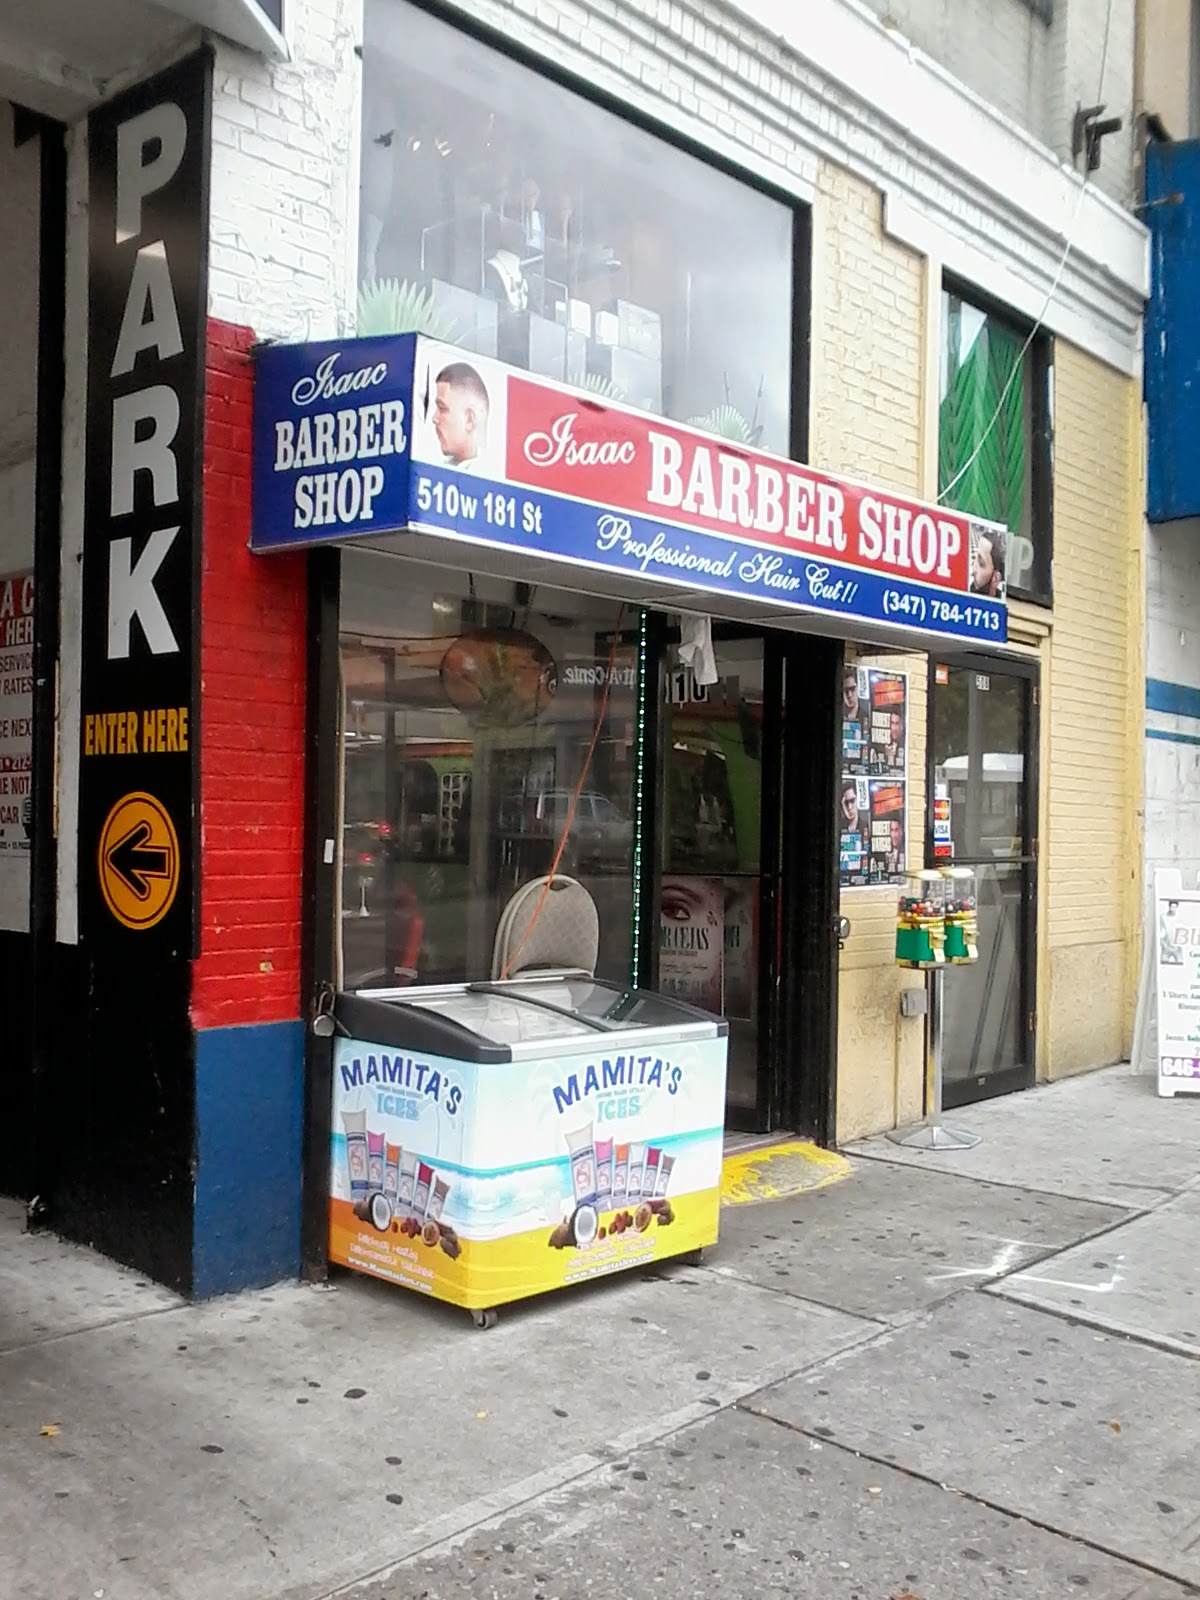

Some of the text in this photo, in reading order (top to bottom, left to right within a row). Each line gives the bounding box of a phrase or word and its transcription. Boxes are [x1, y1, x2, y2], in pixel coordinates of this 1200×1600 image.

[107, 102, 188, 660] PARK
[291, 352, 387, 406] Isaac
[274, 400, 407, 472] BARBER
[294, 465, 384, 529] SHOP
[417, 477, 542, 535] 510w 181 St
[524, 413, 961, 578] Isaac BARBER SHOP
[597, 514, 859, 604] Professional Hair Cut!!
[882, 589, 1000, 631] (347) 784-1713
[85, 707, 188, 756] ENTER HERE
[340, 1054, 463, 1116] MAMITA'S
[376, 1092, 420, 1122] ICES
[553, 1055, 682, 1114] MAMITA'S
[597, 1096, 642, 1123] ICES
